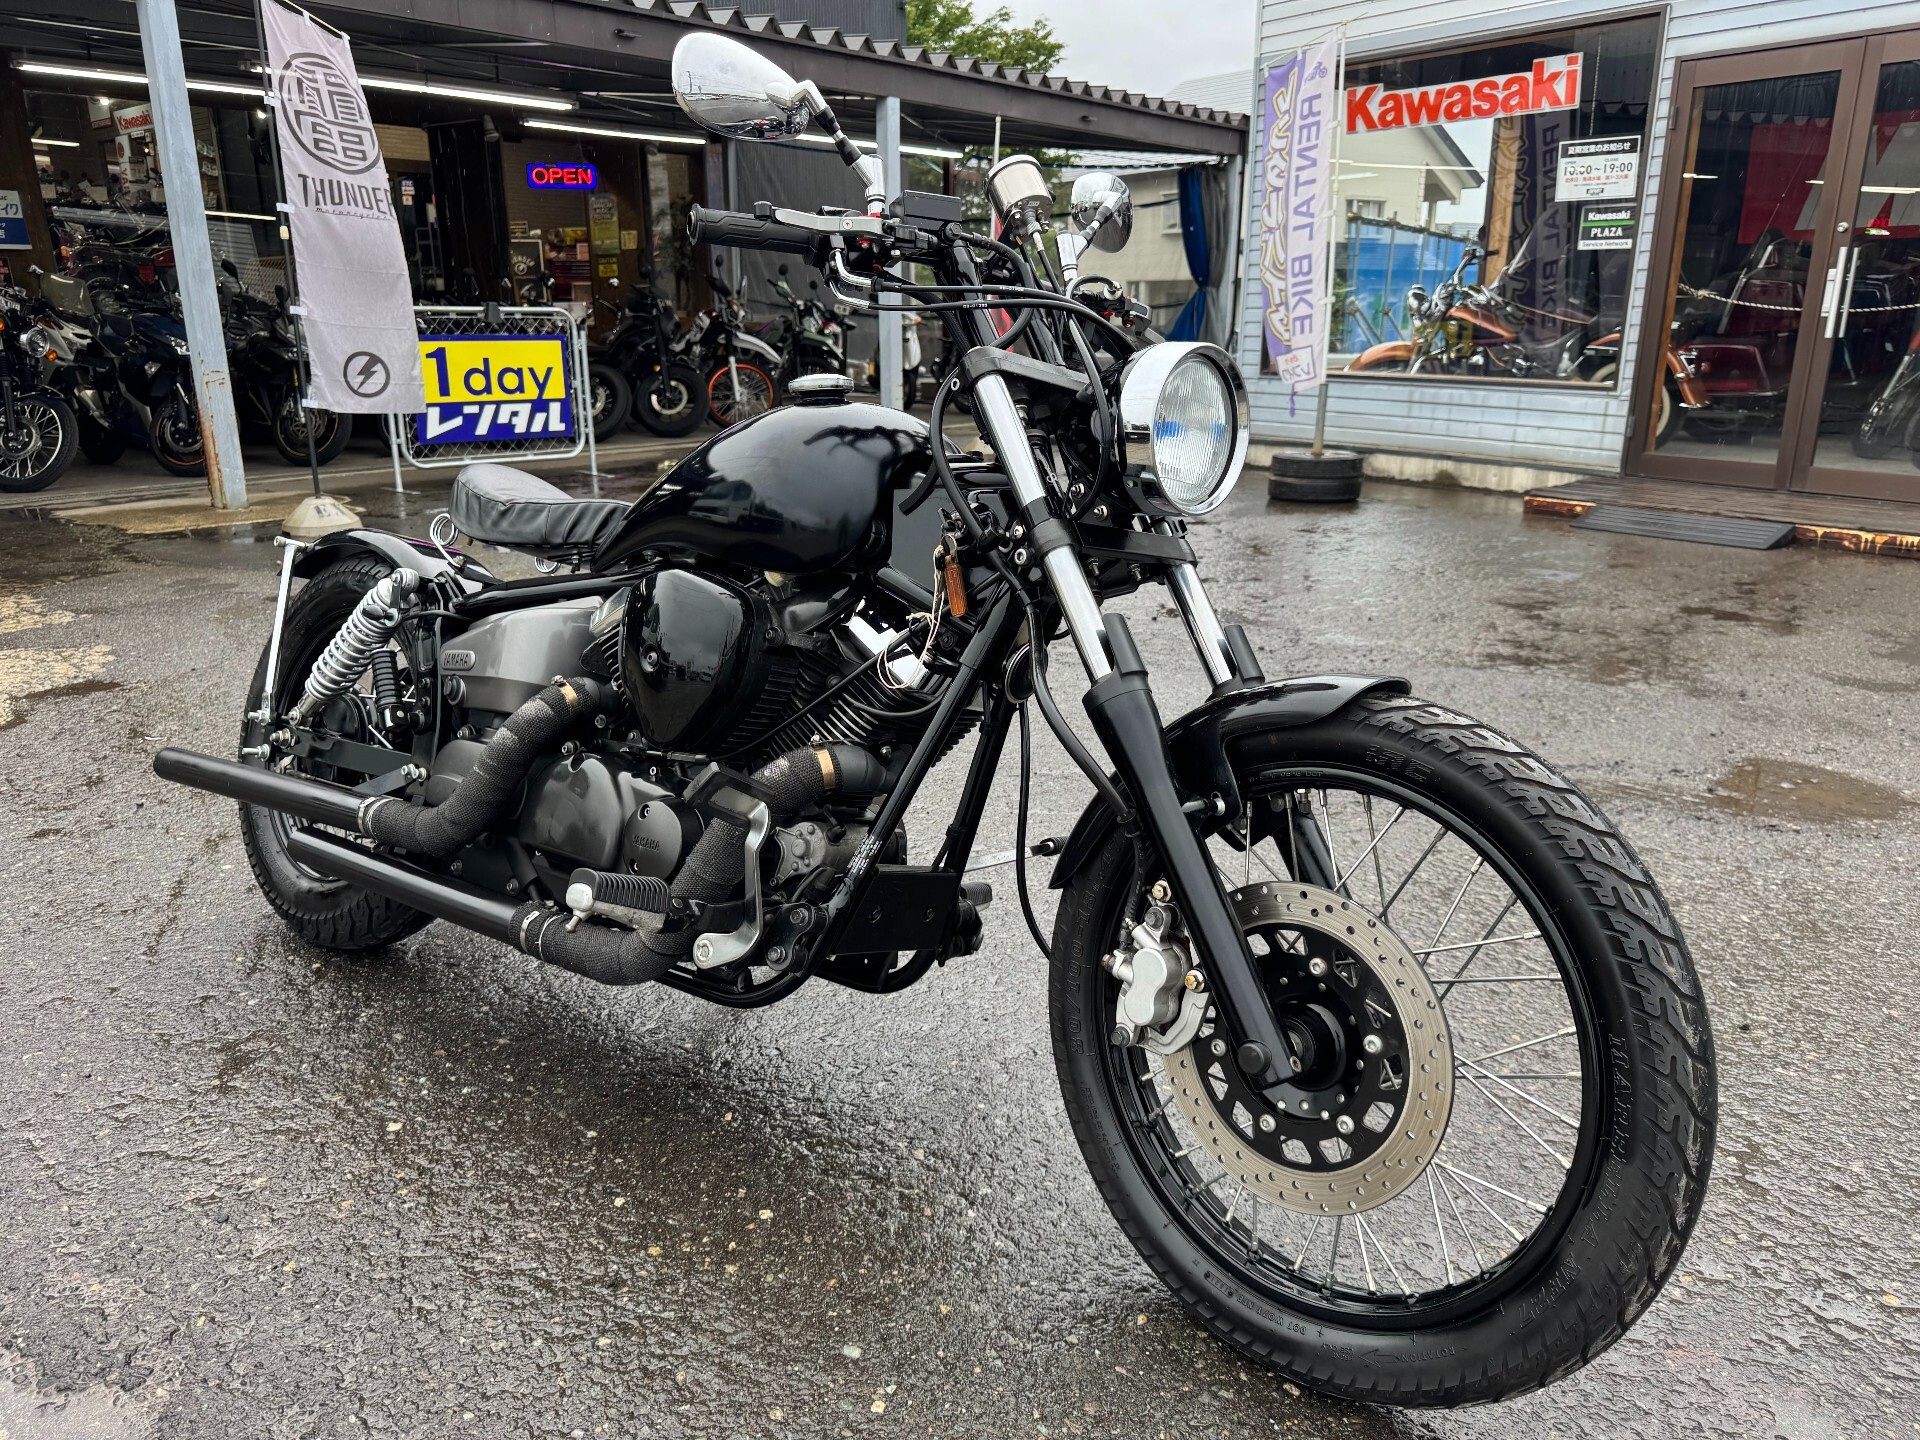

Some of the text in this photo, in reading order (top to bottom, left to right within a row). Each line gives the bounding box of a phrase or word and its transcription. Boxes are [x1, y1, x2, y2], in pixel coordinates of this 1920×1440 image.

[1347, 55, 1580, 132] Kawasaki
[117, 110, 153, 129] Kawasaki
[532, 167, 593, 184] OPEN
[1588, 211, 1631, 221] Kawasaki
[1590, 227, 1623, 237] PLAZA
[426, 347, 554, 401] 1 day
[426, 402, 566, 440] レンタル
[444, 653, 469, 667] YAMAHA
[632, 834, 660, 852] YAMAHA
